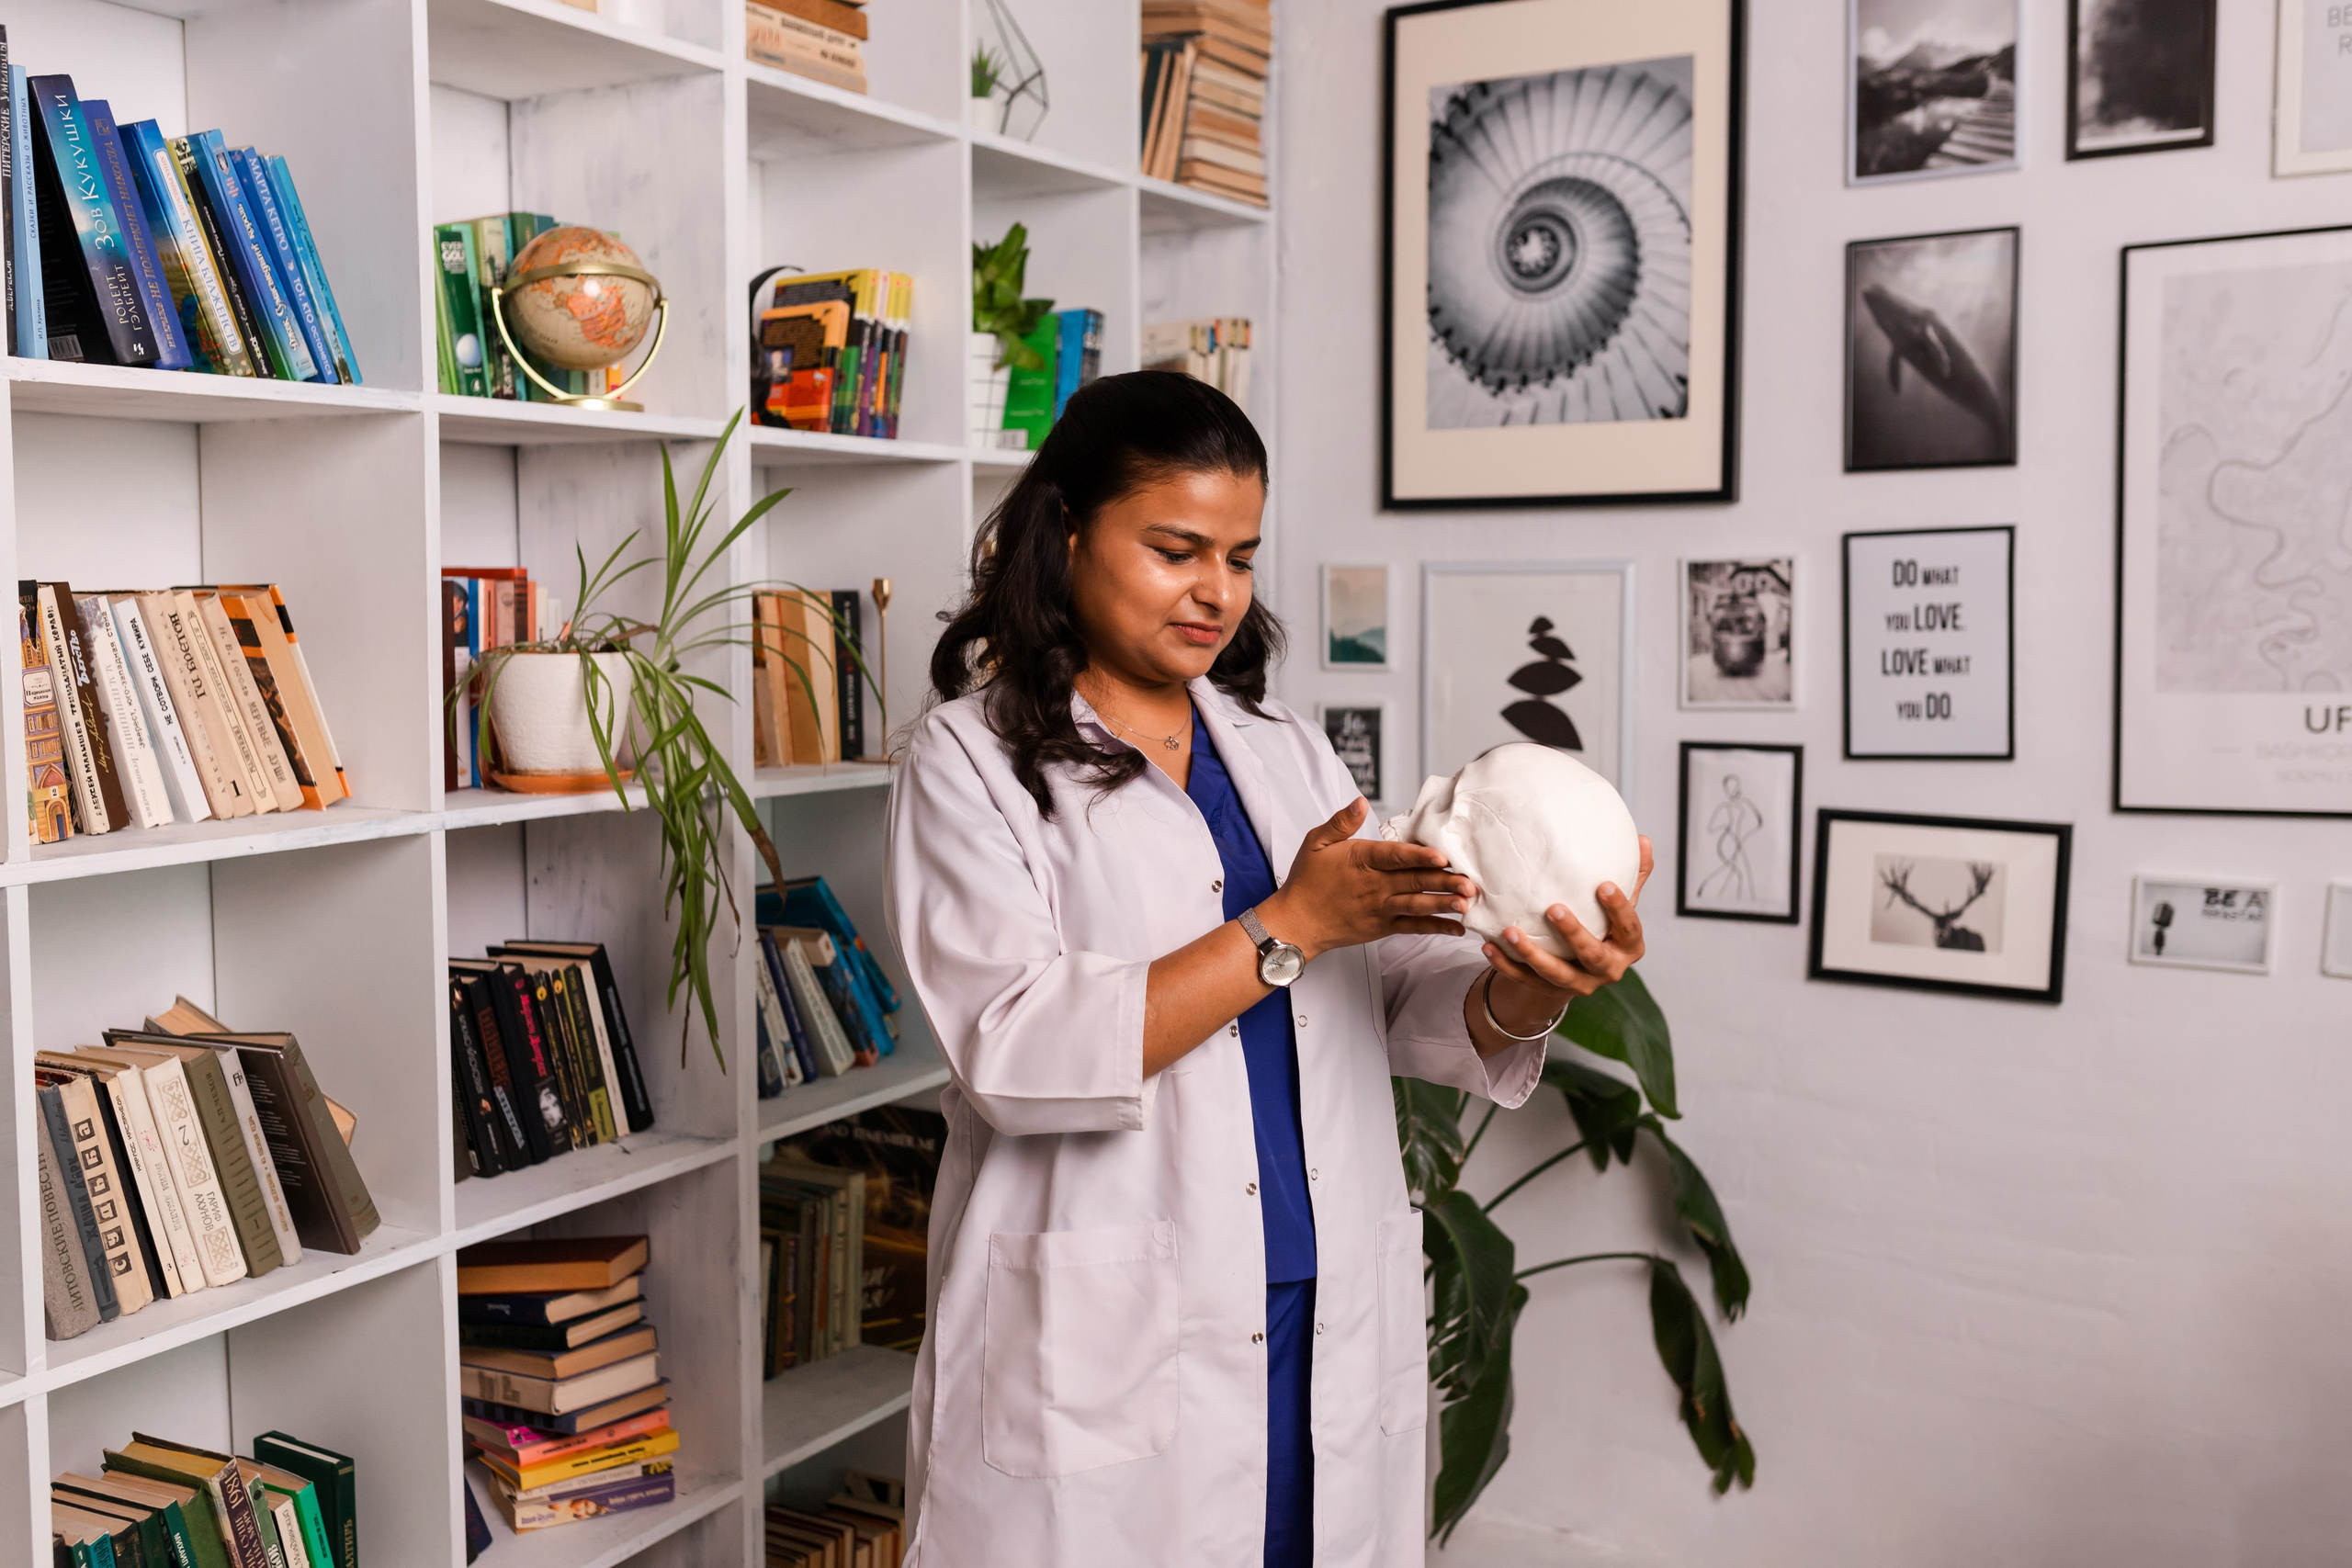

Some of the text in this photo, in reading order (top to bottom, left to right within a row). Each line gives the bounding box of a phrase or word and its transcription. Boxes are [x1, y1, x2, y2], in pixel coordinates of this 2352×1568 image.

[20, 96, 29, 140] ЖИВОТНЫХ
[1, 107, 12, 178] ПИТЕРСКИЕ
[23, 154, 34, 196] РАССКАЗЫ
[105, 141, 131, 201] НИКОГДА
[123, 202, 154, 279] ПОМЕРКНЕТ
[248, 157, 272, 207] МАРТА
[266, 207, 288, 252] КЕТРО
[301, 302, 314, 324] КТО
[106, 275, 130, 324] РОБЕРТ
[114, 264, 142, 331] ГЭЛБРЕЙТ
[147, 281, 163, 299] НЕ
[183, 219, 206, 265] КНИГА
[201, 267, 239, 348] БЛАЖЕНСТВ
[1893, 559, 1959, 587] DO WHAT
[102, 611, 113, 637] стена
[130, 617, 147, 650] КУМИРА
[1885, 614, 1910, 631] YOU
[109, 640, 133, 706] юго-западная
[141, 652, 154, 673] СЕБЕ
[1882, 648, 1971, 676] LOVE WHAT
[150, 675, 169, 712] СОТВОРИ
[1896, 702, 1922, 720] YOU
[164, 714, 174, 726] НЕ
[248, 701, 273, 748] МЕРТВЫЕ
[267, 754, 288, 783] ДУШИ
[128, 1141, 141, 1172] КАРЛОС
[194, 1192, 215, 1232] АХУНОВ
[206, 1190, 222, 1223] ГАРИФ
[51, 1224, 85, 1313] ЛИТОВСКИЕ
[223, 1472, 244, 1510] 1981
[233, 1515, 250, 1549] СУШЕ
[242, 1506, 256, 1540] МОРЕ
[173, 1532, 189, 1567] МИХАИЛ
[253, 1540, 265, 1562] НА
